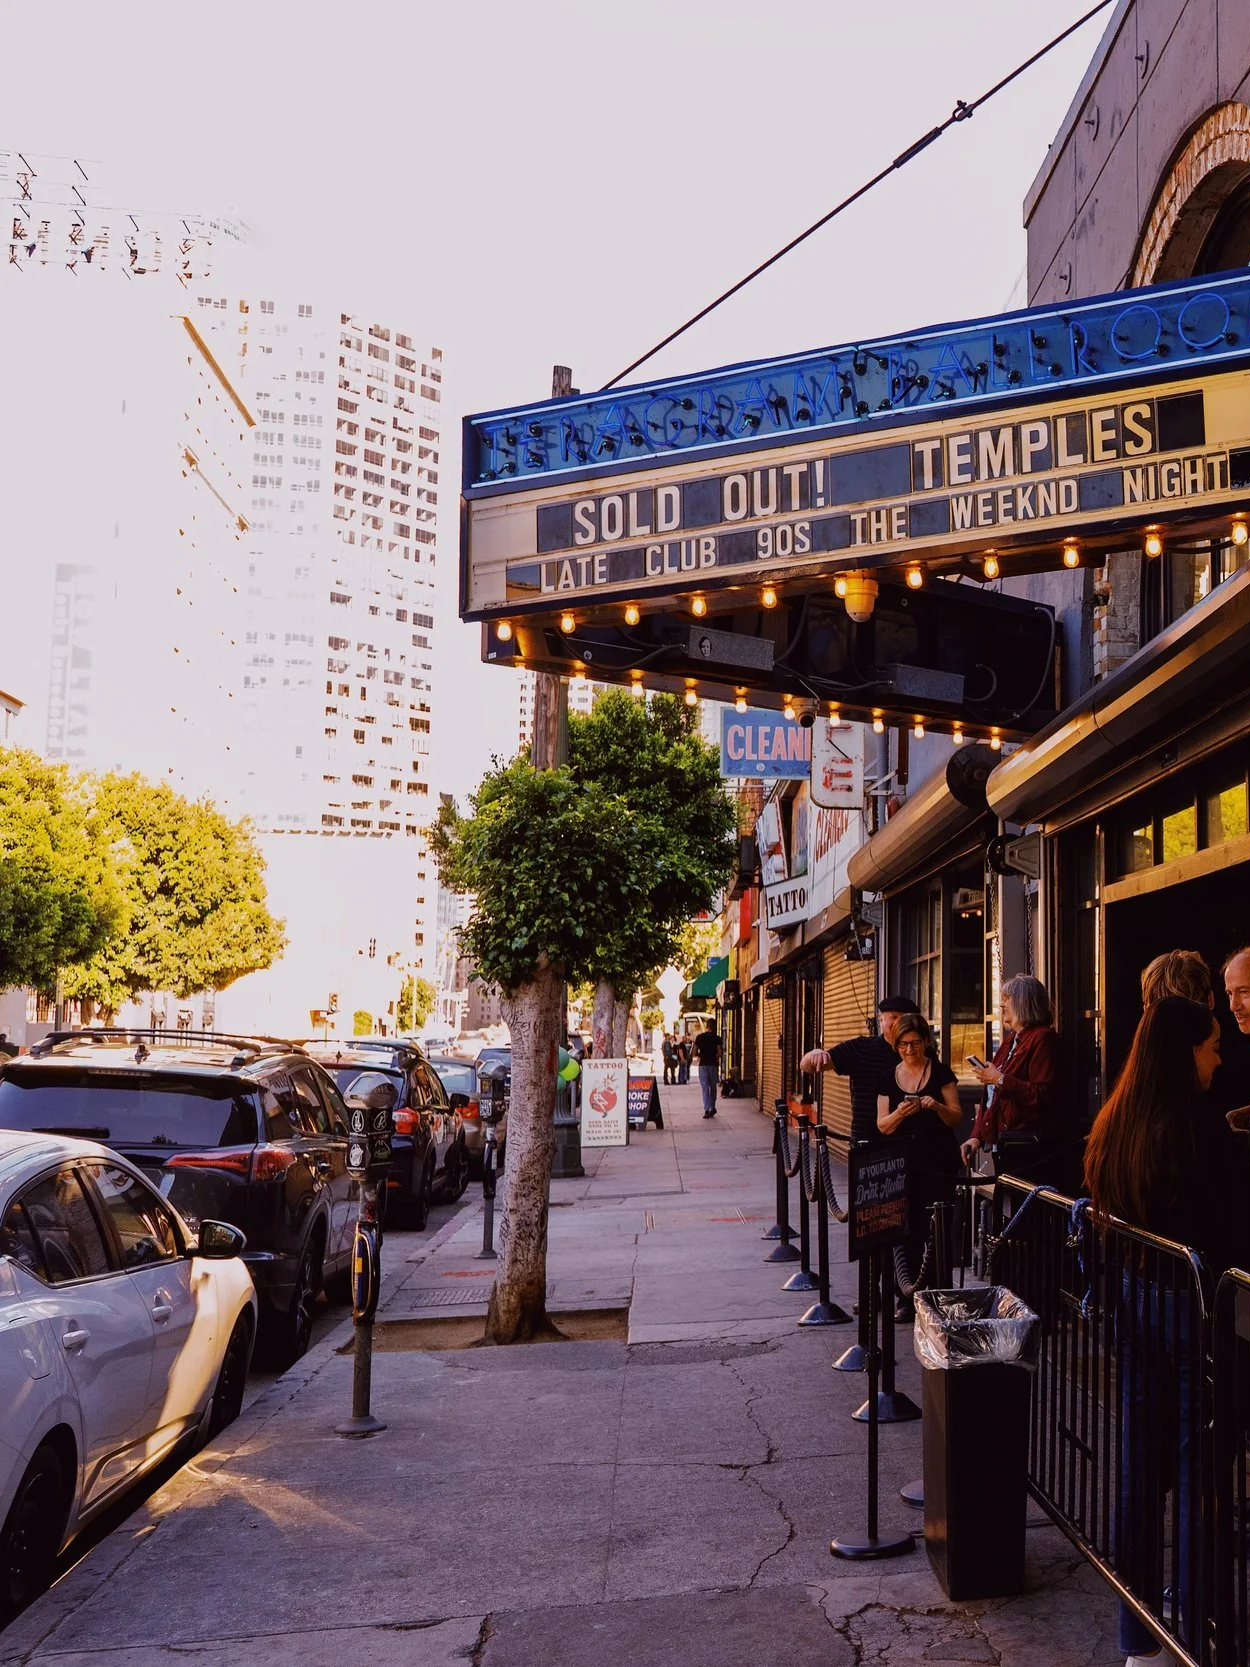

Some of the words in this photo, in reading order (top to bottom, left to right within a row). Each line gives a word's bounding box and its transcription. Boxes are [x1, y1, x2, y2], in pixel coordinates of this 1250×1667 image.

[483, 362, 844, 474] TERAGRAM
[573, 486, 681, 546] SOLD
[722, 459, 829, 522] OUT!
[914, 402, 1153, 491] TEMPLES
[539, 553, 608, 594] LATE
[645, 536, 717, 577] CLUB
[756, 521, 811, 559] 90S
[850, 505, 909, 546] THE
[951, 478, 1079, 531] WEEKND
[1122, 453, 1228, 505] NIGHT
[768, 886, 809, 918] TATTO
[854, 1180, 879, 1206] Drink
[880, 1173, 906, 1198] Alcohol
[859, 1168, 866, 1180] IF
[866, 1163, 880, 1178] YOU
[880, 1159, 897, 1173] PLAN
[896, 1157, 905, 1169] TO
